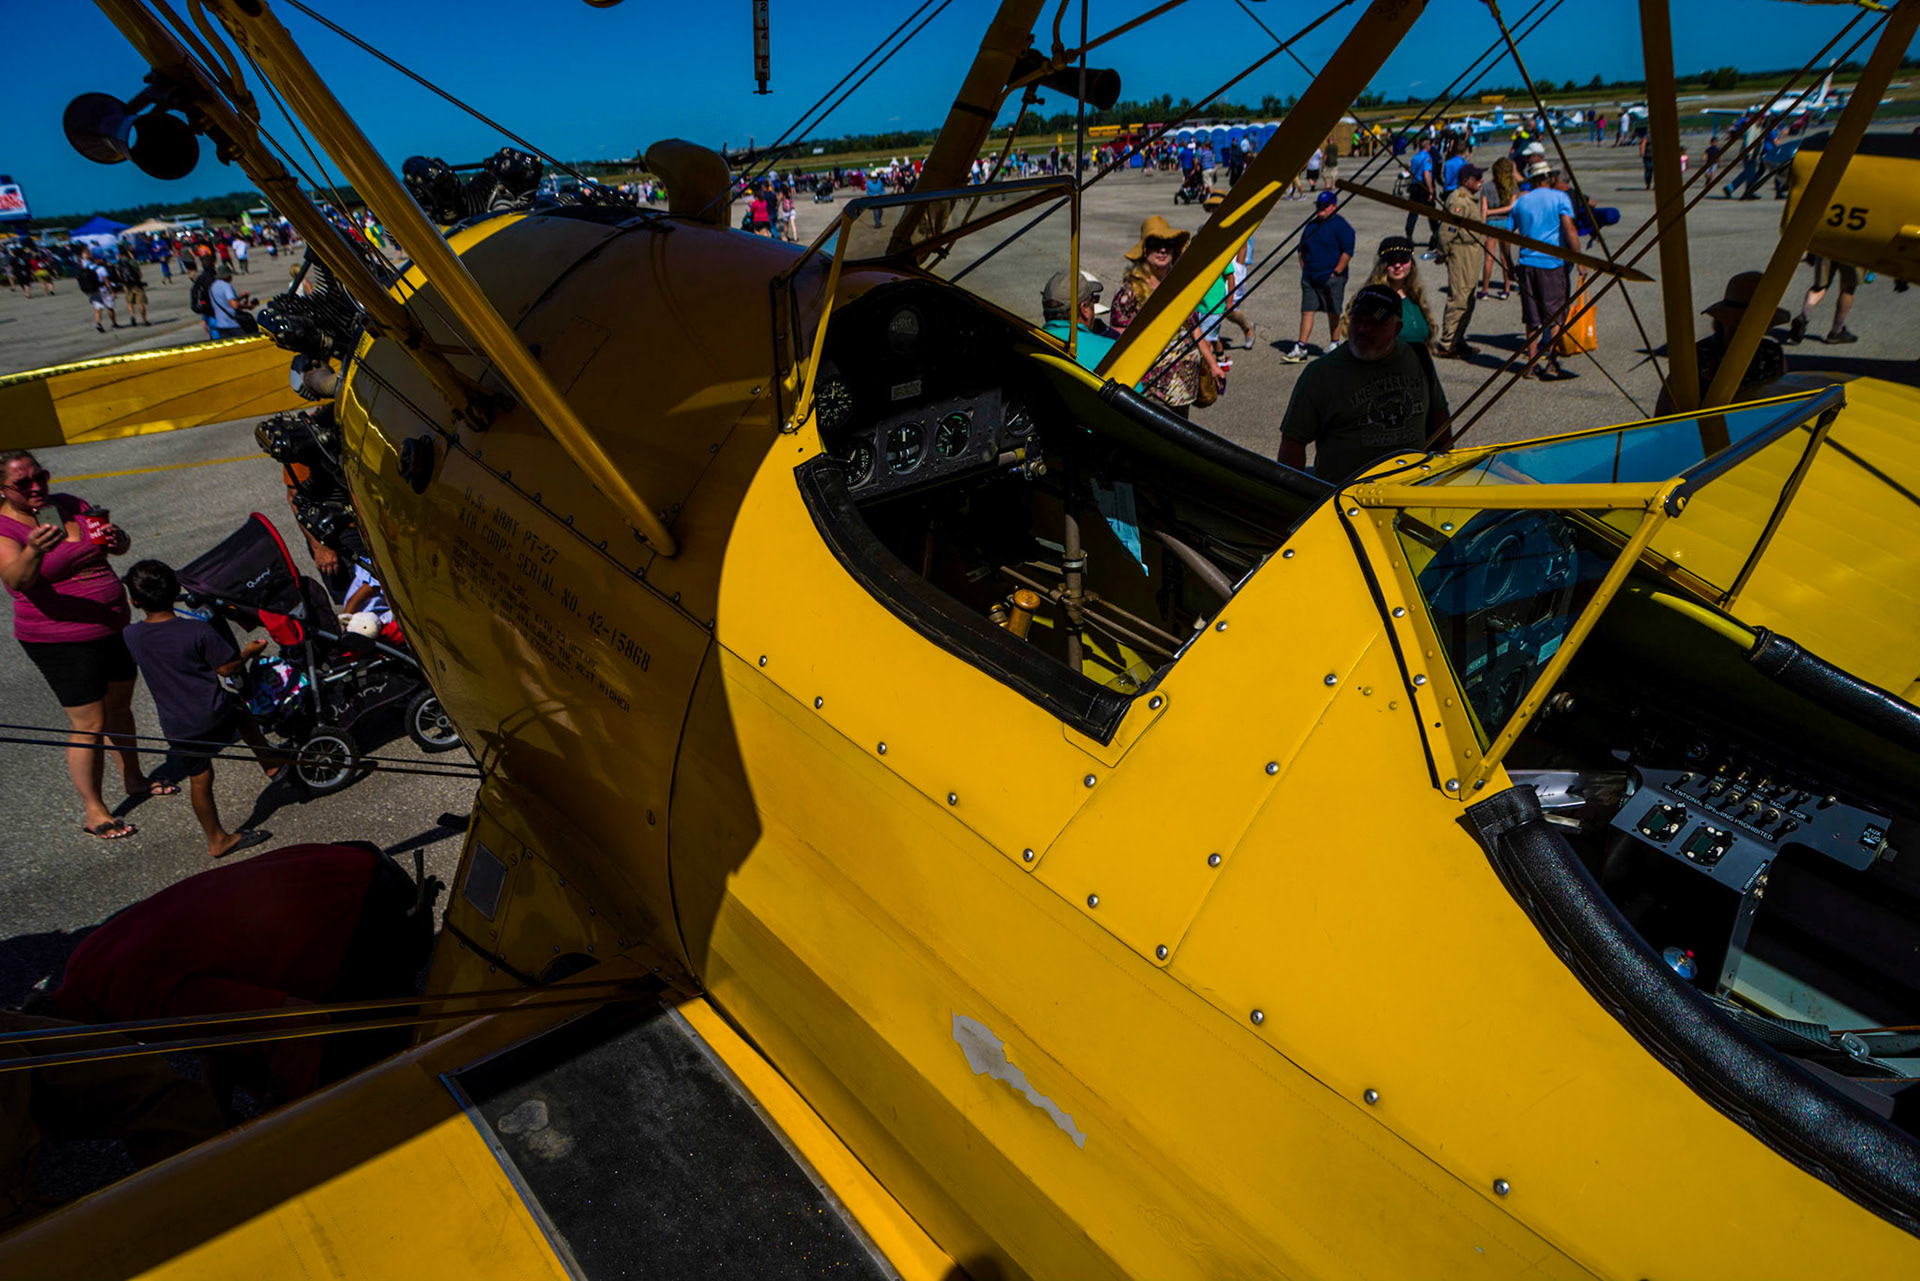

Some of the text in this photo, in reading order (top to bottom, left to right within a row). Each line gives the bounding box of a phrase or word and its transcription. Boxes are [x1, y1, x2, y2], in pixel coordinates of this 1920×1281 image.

[1826, 203, 1869, 231] 35
[465, 486, 560, 565] U.S. ARMY PT-27
[458, 507, 651, 673] AIR CORPS SERIAL NO. 42-15868
[1714, 774, 1727, 785] BAT
[1732, 783, 1748, 794] GEN
[1751, 792, 1766, 802] NAV
[1769, 799, 1787, 811] TACH
[1734, 818, 1774, 842] PROHIBITED
[1863, 830, 1881, 842] PLUG
[1867, 826, 1882, 837] AUX
